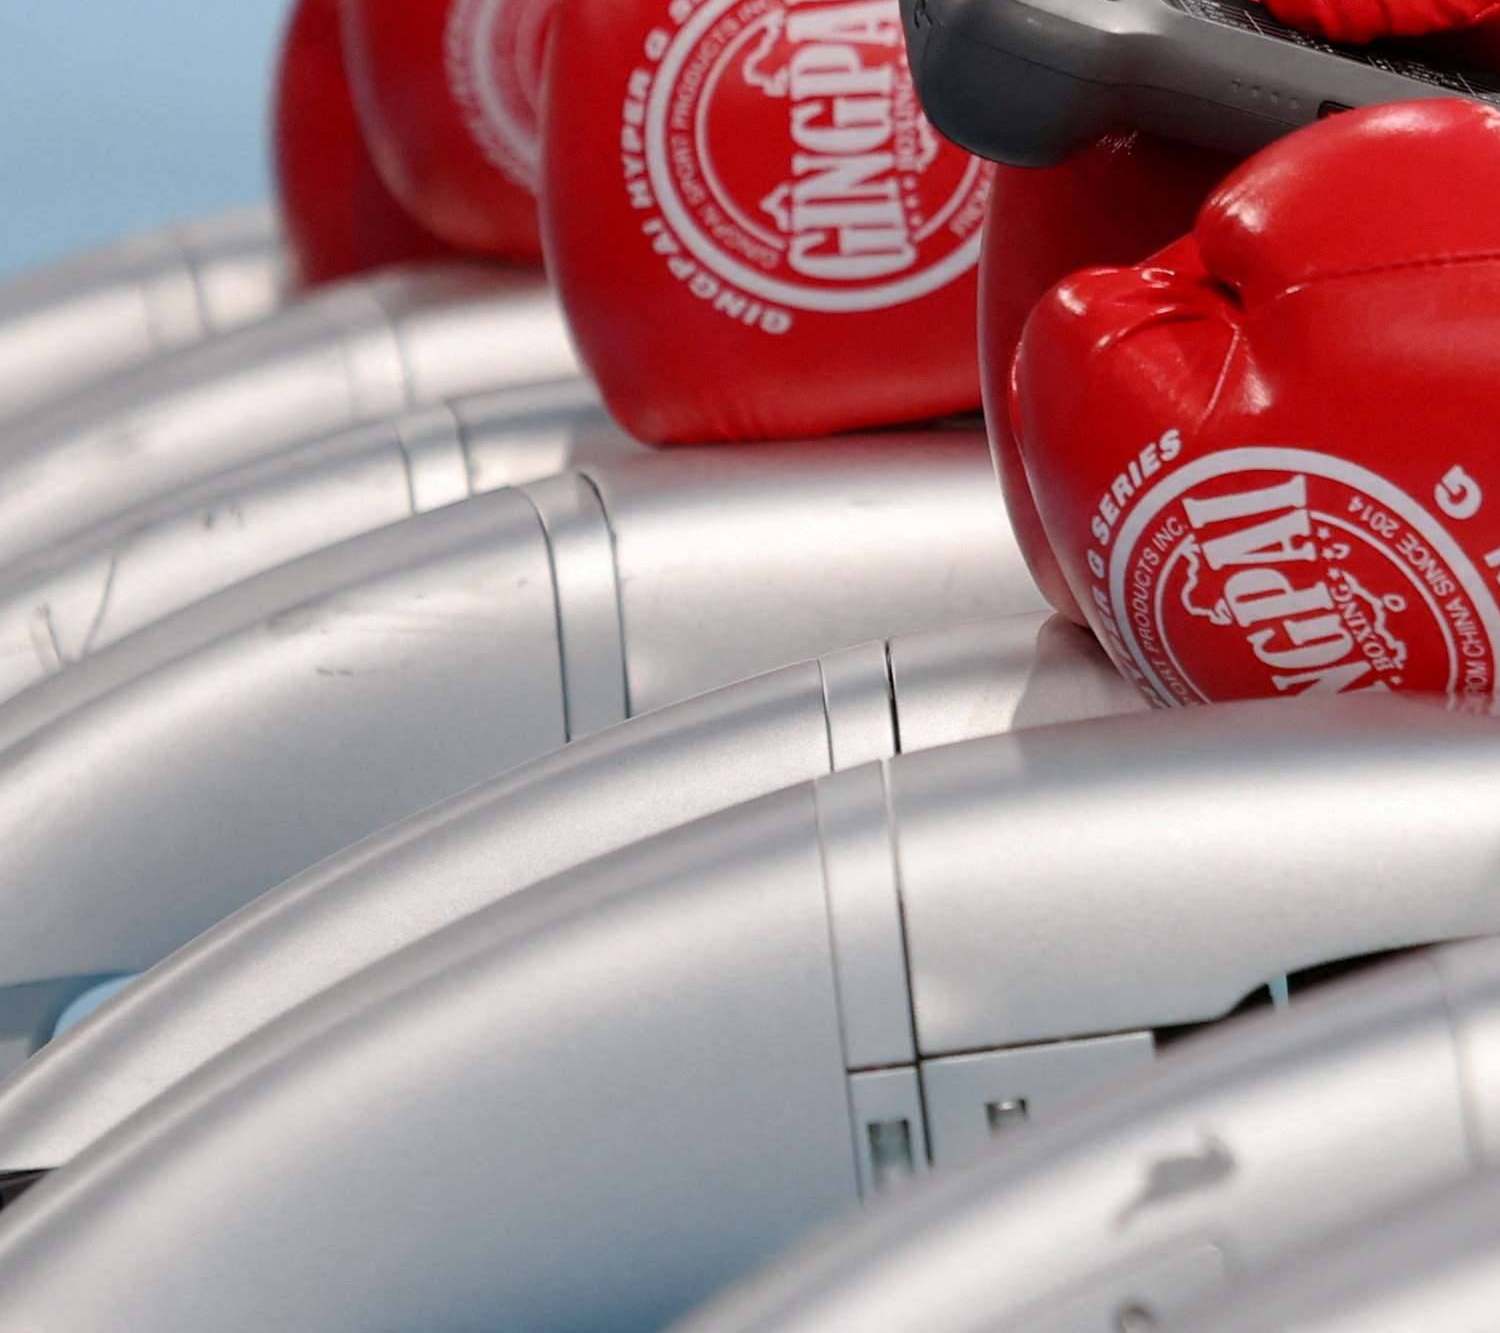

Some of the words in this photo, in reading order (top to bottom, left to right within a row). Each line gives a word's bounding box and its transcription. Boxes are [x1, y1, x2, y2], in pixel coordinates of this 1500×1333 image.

[620, 67, 654, 210] HYPER
[1091, 429, 1182, 546] SERIES
[1347, 495, 1400, 539] 2014
[1132, 546, 1161, 651] PRODUCTS
[1152, 516, 1188, 553] INC.
[1394, 532, 1455, 597] SINCE
[1330, 581, 1395, 672] BOXING
[1445, 595, 1486, 659] CHINA
[1463, 660, 1489, 696] ROM
